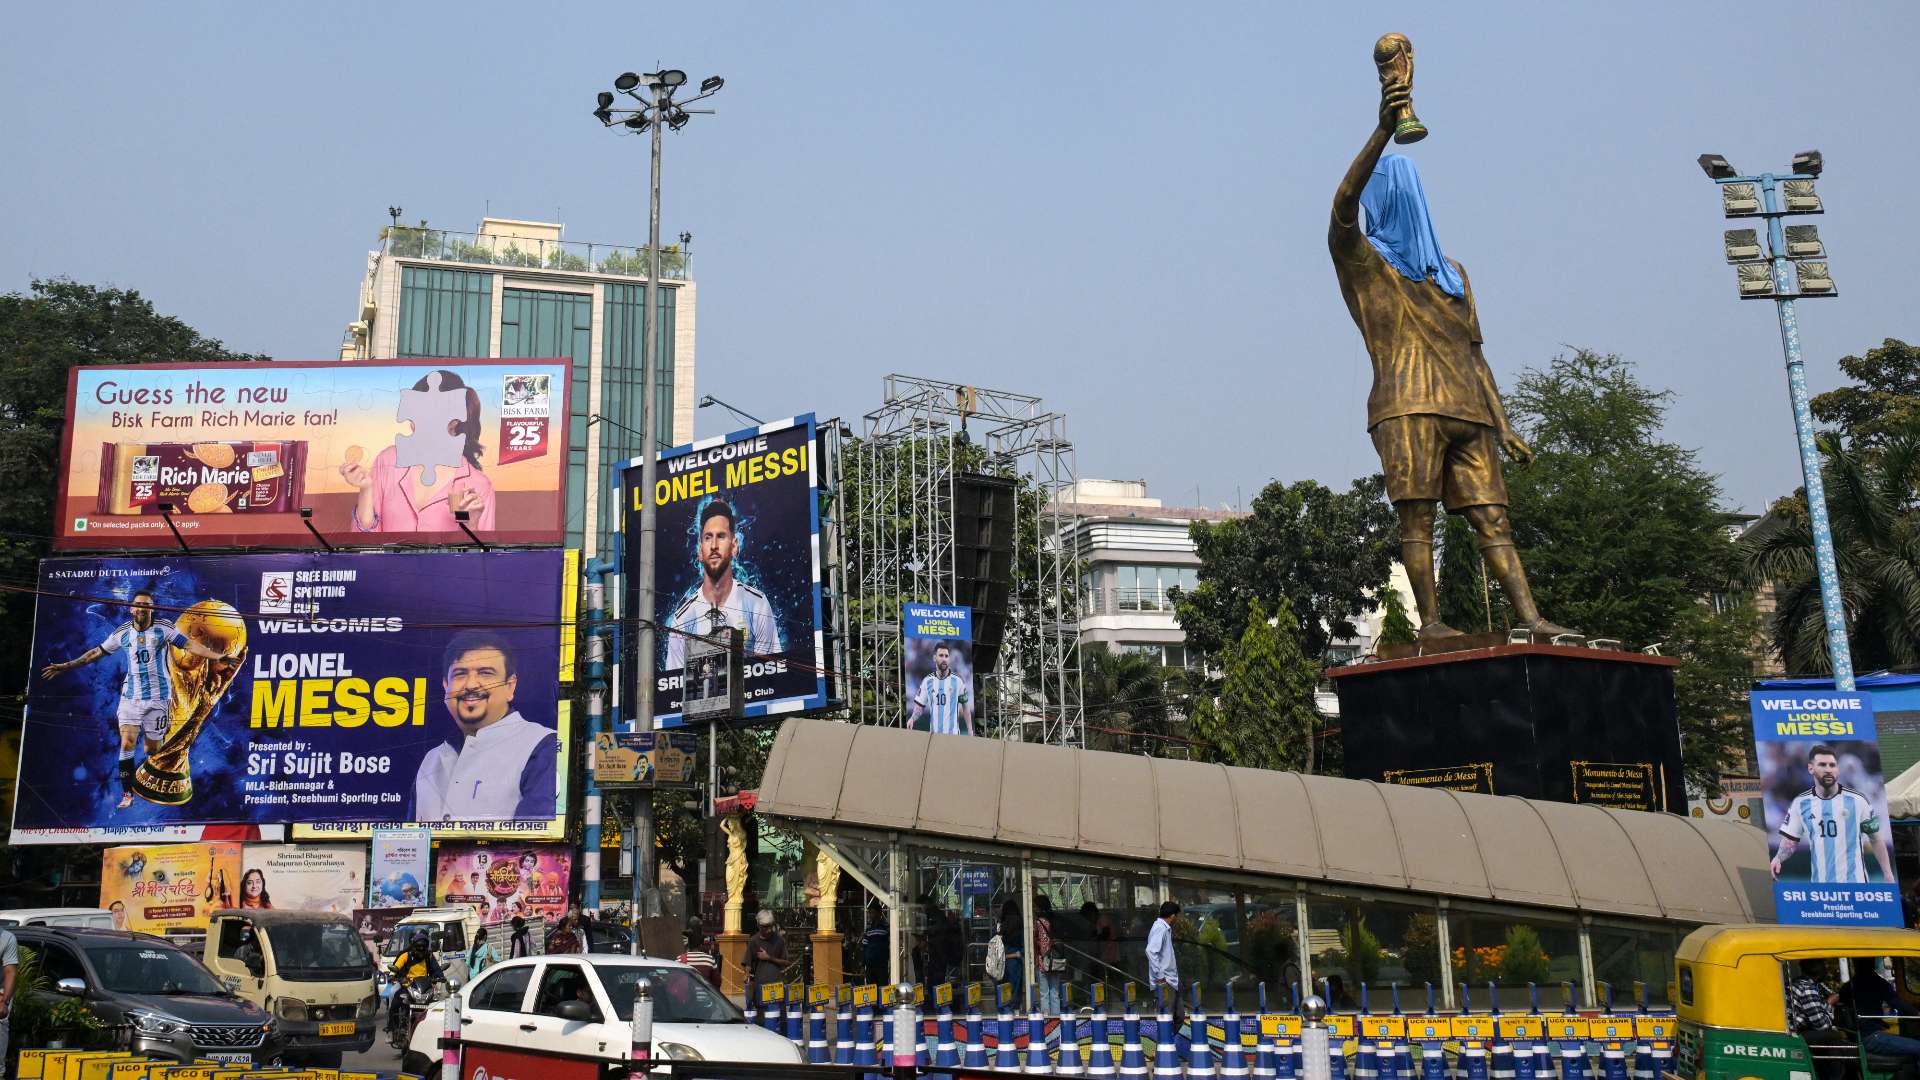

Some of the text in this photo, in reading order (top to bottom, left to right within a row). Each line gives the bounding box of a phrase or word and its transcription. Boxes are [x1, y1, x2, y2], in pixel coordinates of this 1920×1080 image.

[95, 380, 288, 405] Guess the new
[503, 407, 548, 415] BISK FARM
[111, 408, 338, 428] Bisk Farm Rich Marie fan!
[510, 426, 541, 446] 25
[667, 435, 769, 474] WELCOME
[160, 466, 197, 486] Rich
[201, 466, 250, 485] Marie
[633, 445, 807, 512] LONEL MESSI
[135, 485, 153, 497] 25
[102, 521, 130, 529] selected
[130, 522, 149, 530] packs
[55, 570, 97, 578] SATADRU
[98, 569, 129, 577] DUTTA
[296, 570, 357, 582] SREE BHUMI
[294, 586, 346, 598] SPORTING
[293, 603, 320, 614] CLUB
[911, 608, 965, 619] WELCOME
[258, 617, 403, 634] WELCOMES
[917, 625, 960, 636] MESSI
[135, 649, 151, 664] 10
[253, 653, 353, 679] LIONEL
[657, 675, 683, 692] SRI
[754, 687, 775, 697] Club
[250, 677, 427, 728] MESSI
[936, 693, 946, 706] 10
[1760, 699, 1862, 711] WELCOME
[154, 715, 167, 731] 10
[1787, 713, 1839, 721] LIONEL
[1776, 722, 1855, 735] MESSI
[248, 741, 292, 751] Presented
[295, 741, 306, 752] by
[247, 752, 391, 779] Sri Sujit Bose
[1398, 770, 1477, 785] Monumento de Messi
[1583, 768, 1643, 779] Monumento de Messi
[245, 780, 334, 791] MLA-Bidhannagar &
[244, 793, 401, 805] President, Sreebhumi Sporting Club
[1817, 819, 1838, 838] 10
[305, 852, 333, 861] Bhagwat
[477, 855, 488, 864] 13
[1783, 891, 1894, 902] SRI SUJIT BOSE
[1836, 911, 1862, 919] Sporting
[1723, 1044, 1786, 1059] DREAM
[172, 1070, 200, 1078] UCO
